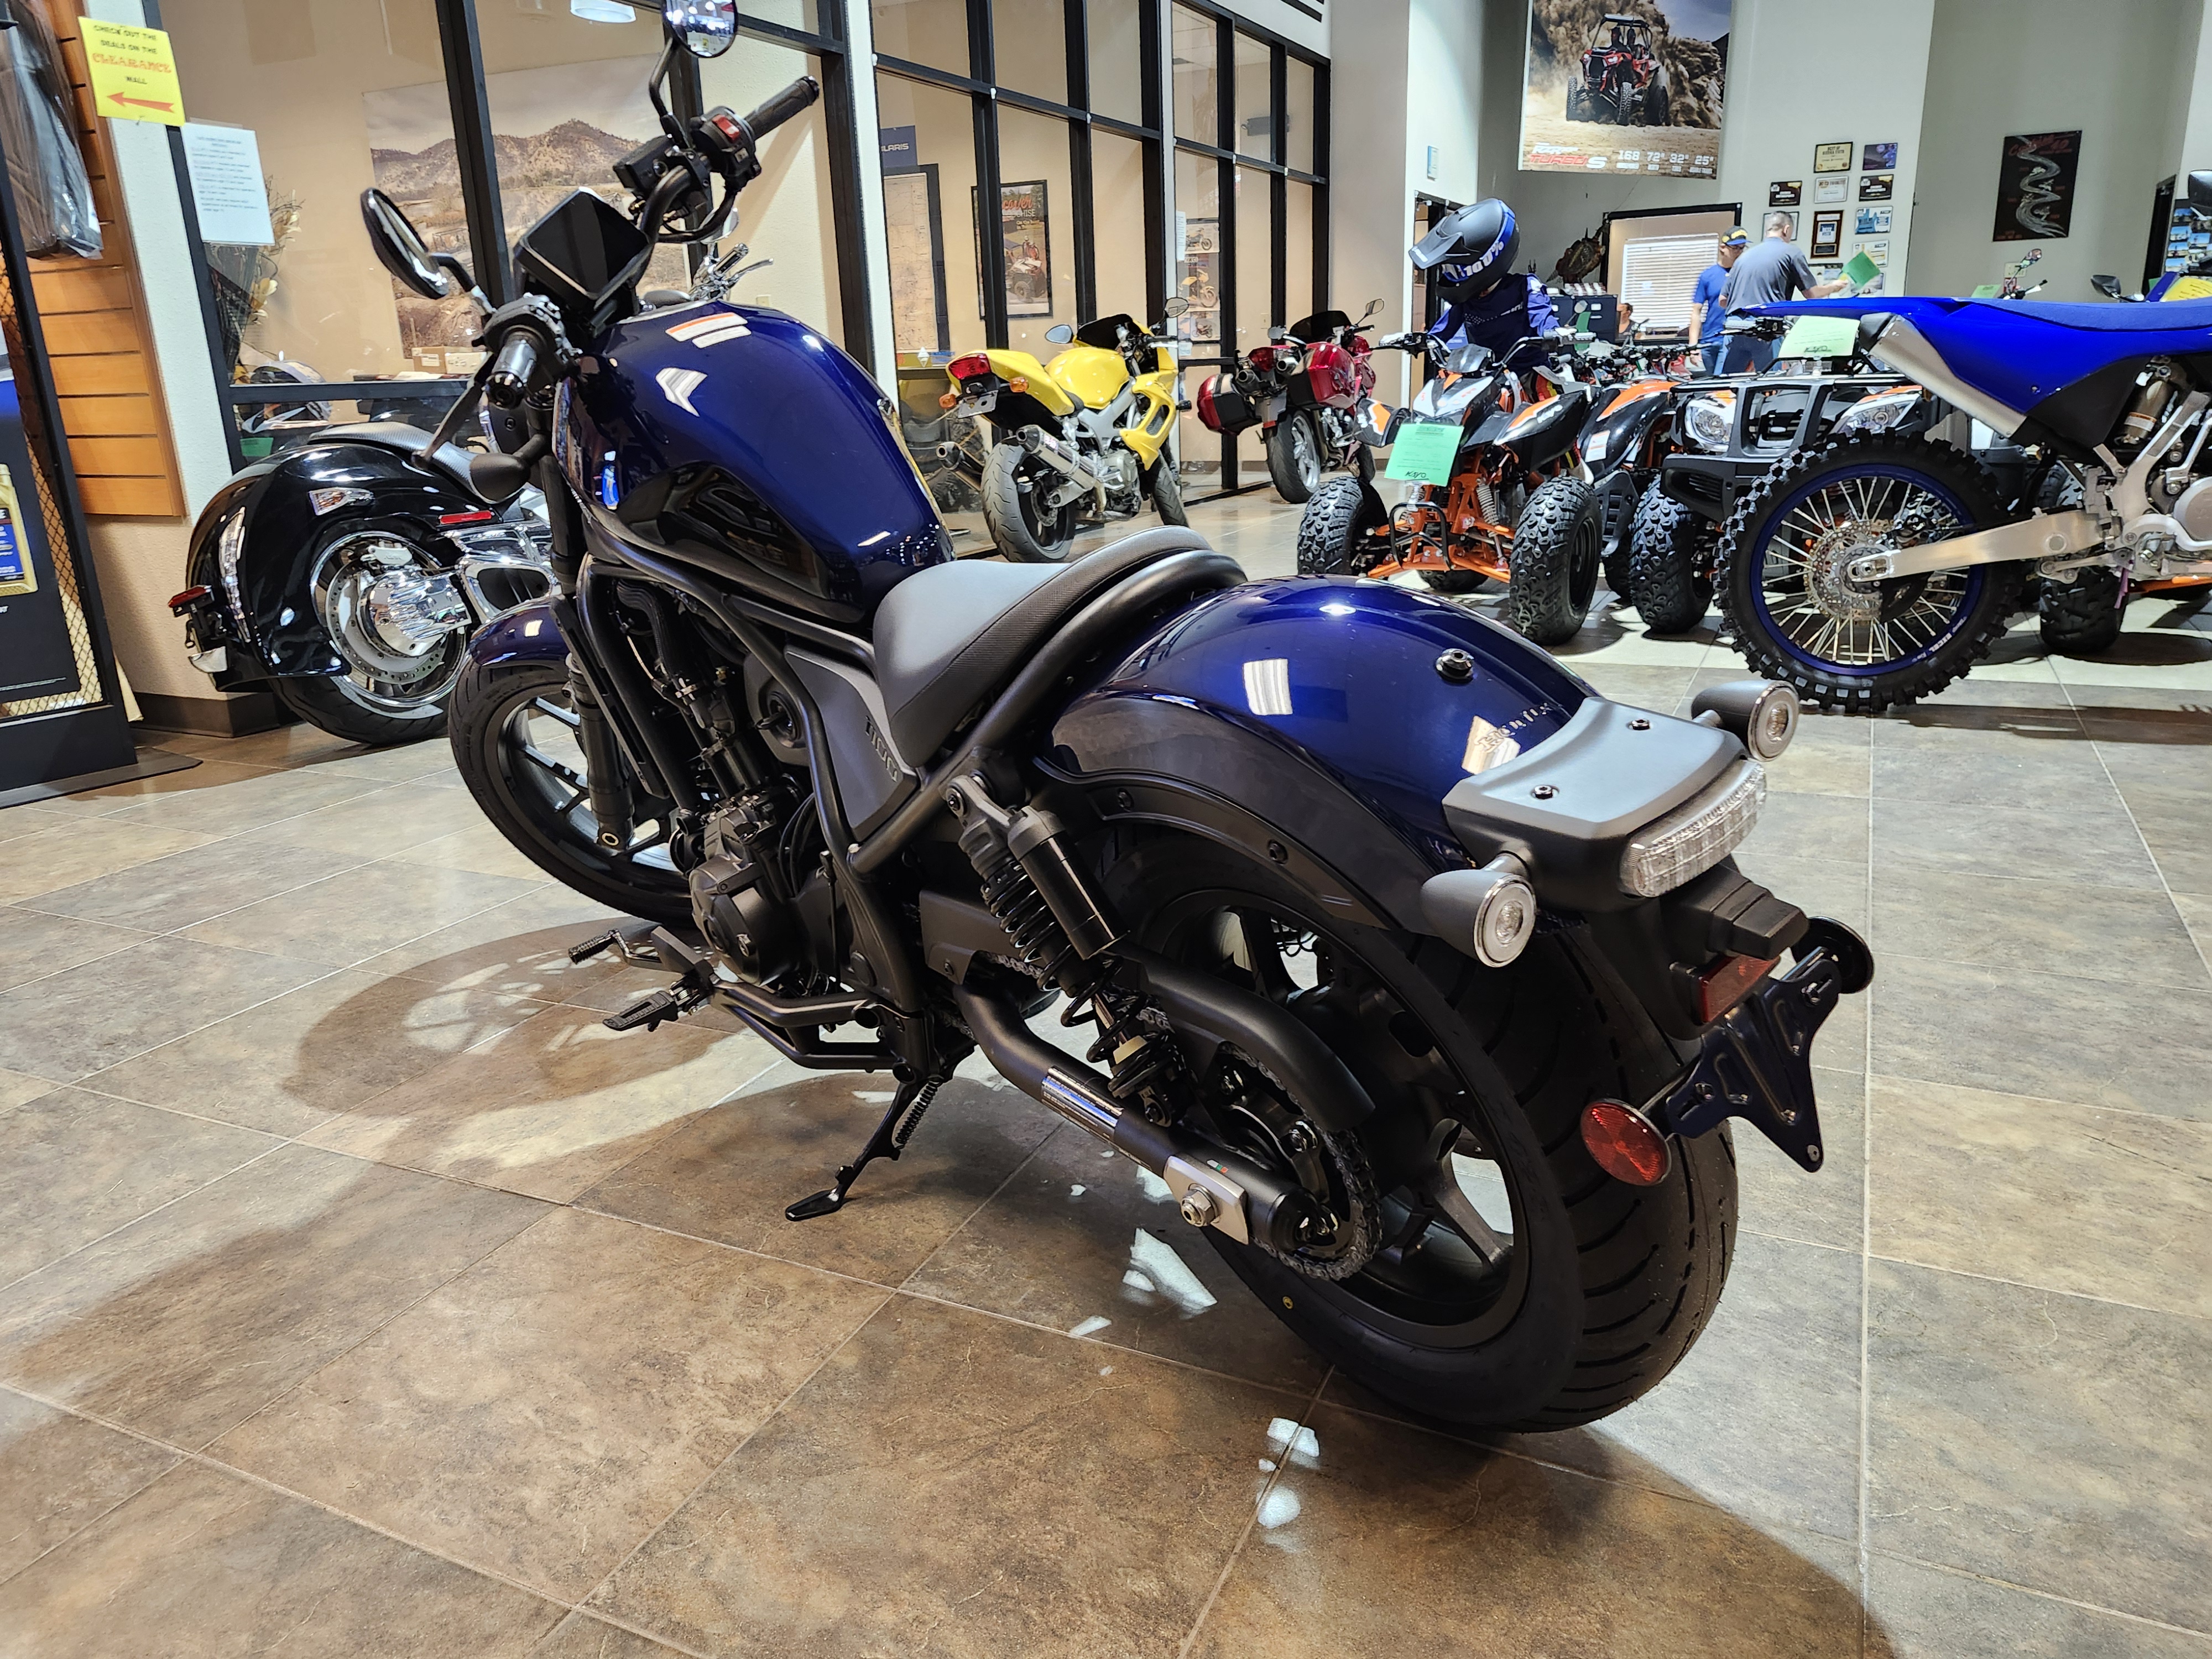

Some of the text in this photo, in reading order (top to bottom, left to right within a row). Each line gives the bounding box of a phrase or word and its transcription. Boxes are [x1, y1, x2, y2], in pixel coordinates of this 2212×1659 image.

[92, 53, 171, 73] CLEARANCE
[1530, 154, 1589, 166] TURBO
[1586, 156, 1608, 169] S
[1618, 150, 1640, 161] 168
[1464, 241, 1505, 276] 100%
